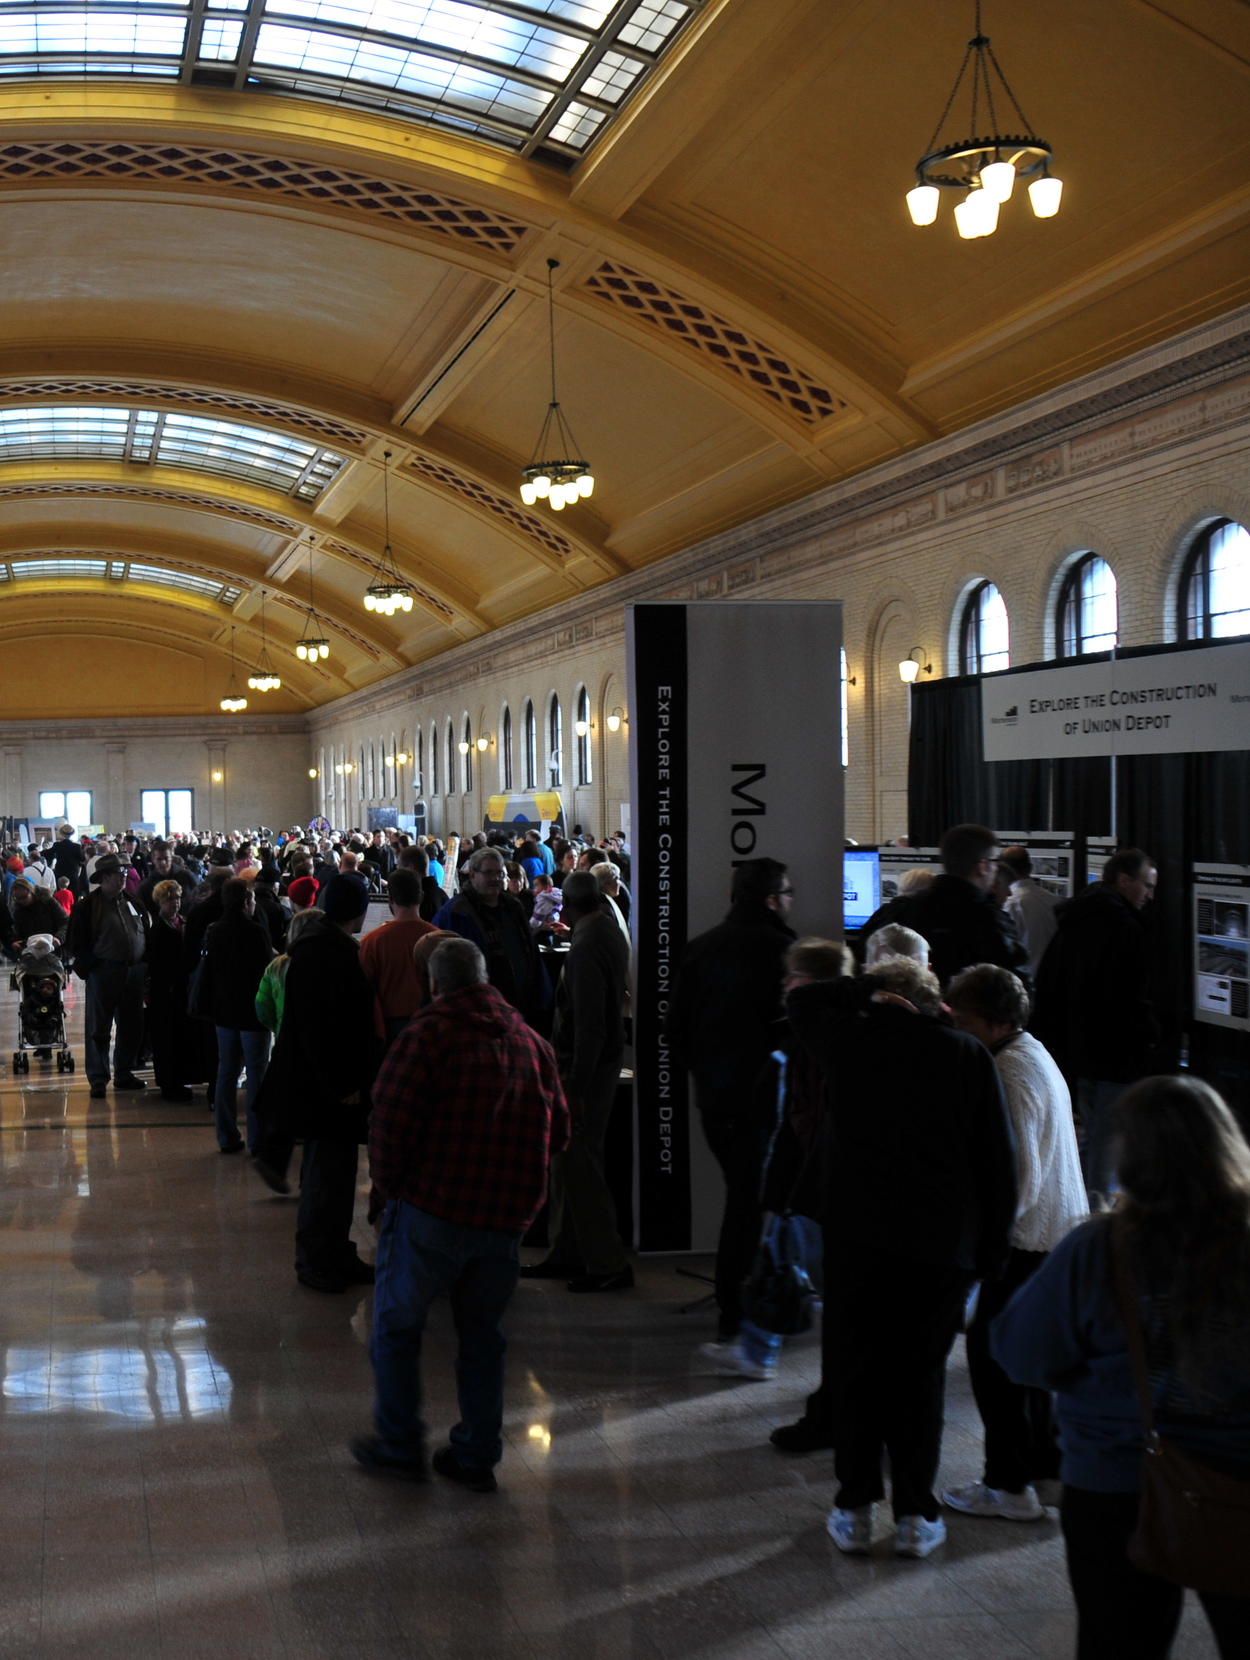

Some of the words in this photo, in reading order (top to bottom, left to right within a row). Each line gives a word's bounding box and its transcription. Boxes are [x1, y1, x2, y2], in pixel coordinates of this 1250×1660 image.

[1030, 697, 1080, 714] EXPLORE
[1084, 694, 1106, 708] THE
[1110, 683, 1217, 706] CONSTRUCTION
[1065, 722, 1079, 735] OF
[1082, 718, 1122, 734] UNION
[1126, 715, 1171, 731] DEPOT
[658, 686, 672, 780] EXPLORE
[658, 787, 671, 827] THE
[658, 834, 672, 992] CONSTRUCTION
[659, 1106, 673, 1174] DEPOT
